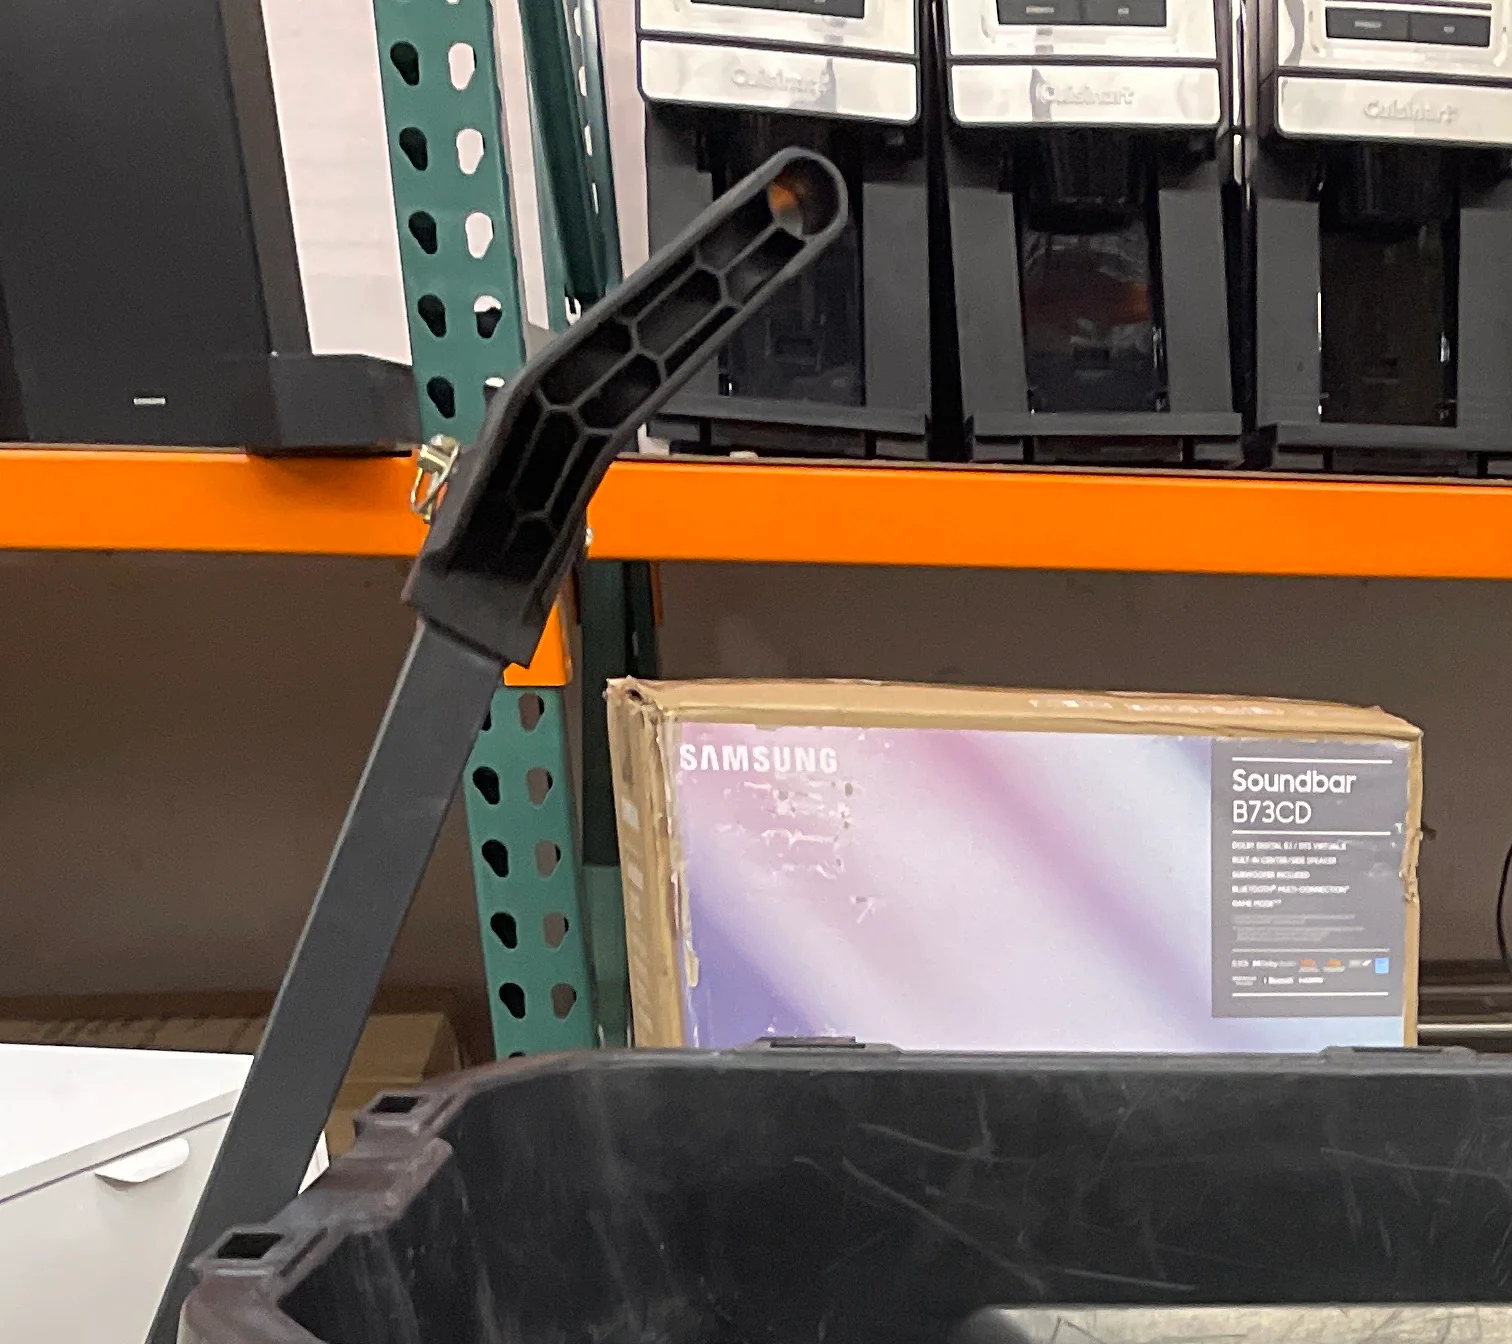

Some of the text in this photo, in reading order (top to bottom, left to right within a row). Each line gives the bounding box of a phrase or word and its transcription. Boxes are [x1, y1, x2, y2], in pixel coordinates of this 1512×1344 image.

[679, 744, 838, 774] SAMSUNG
[1231, 768, 1357, 793] Soundbar
[1232, 800, 1312, 824] B73CD
